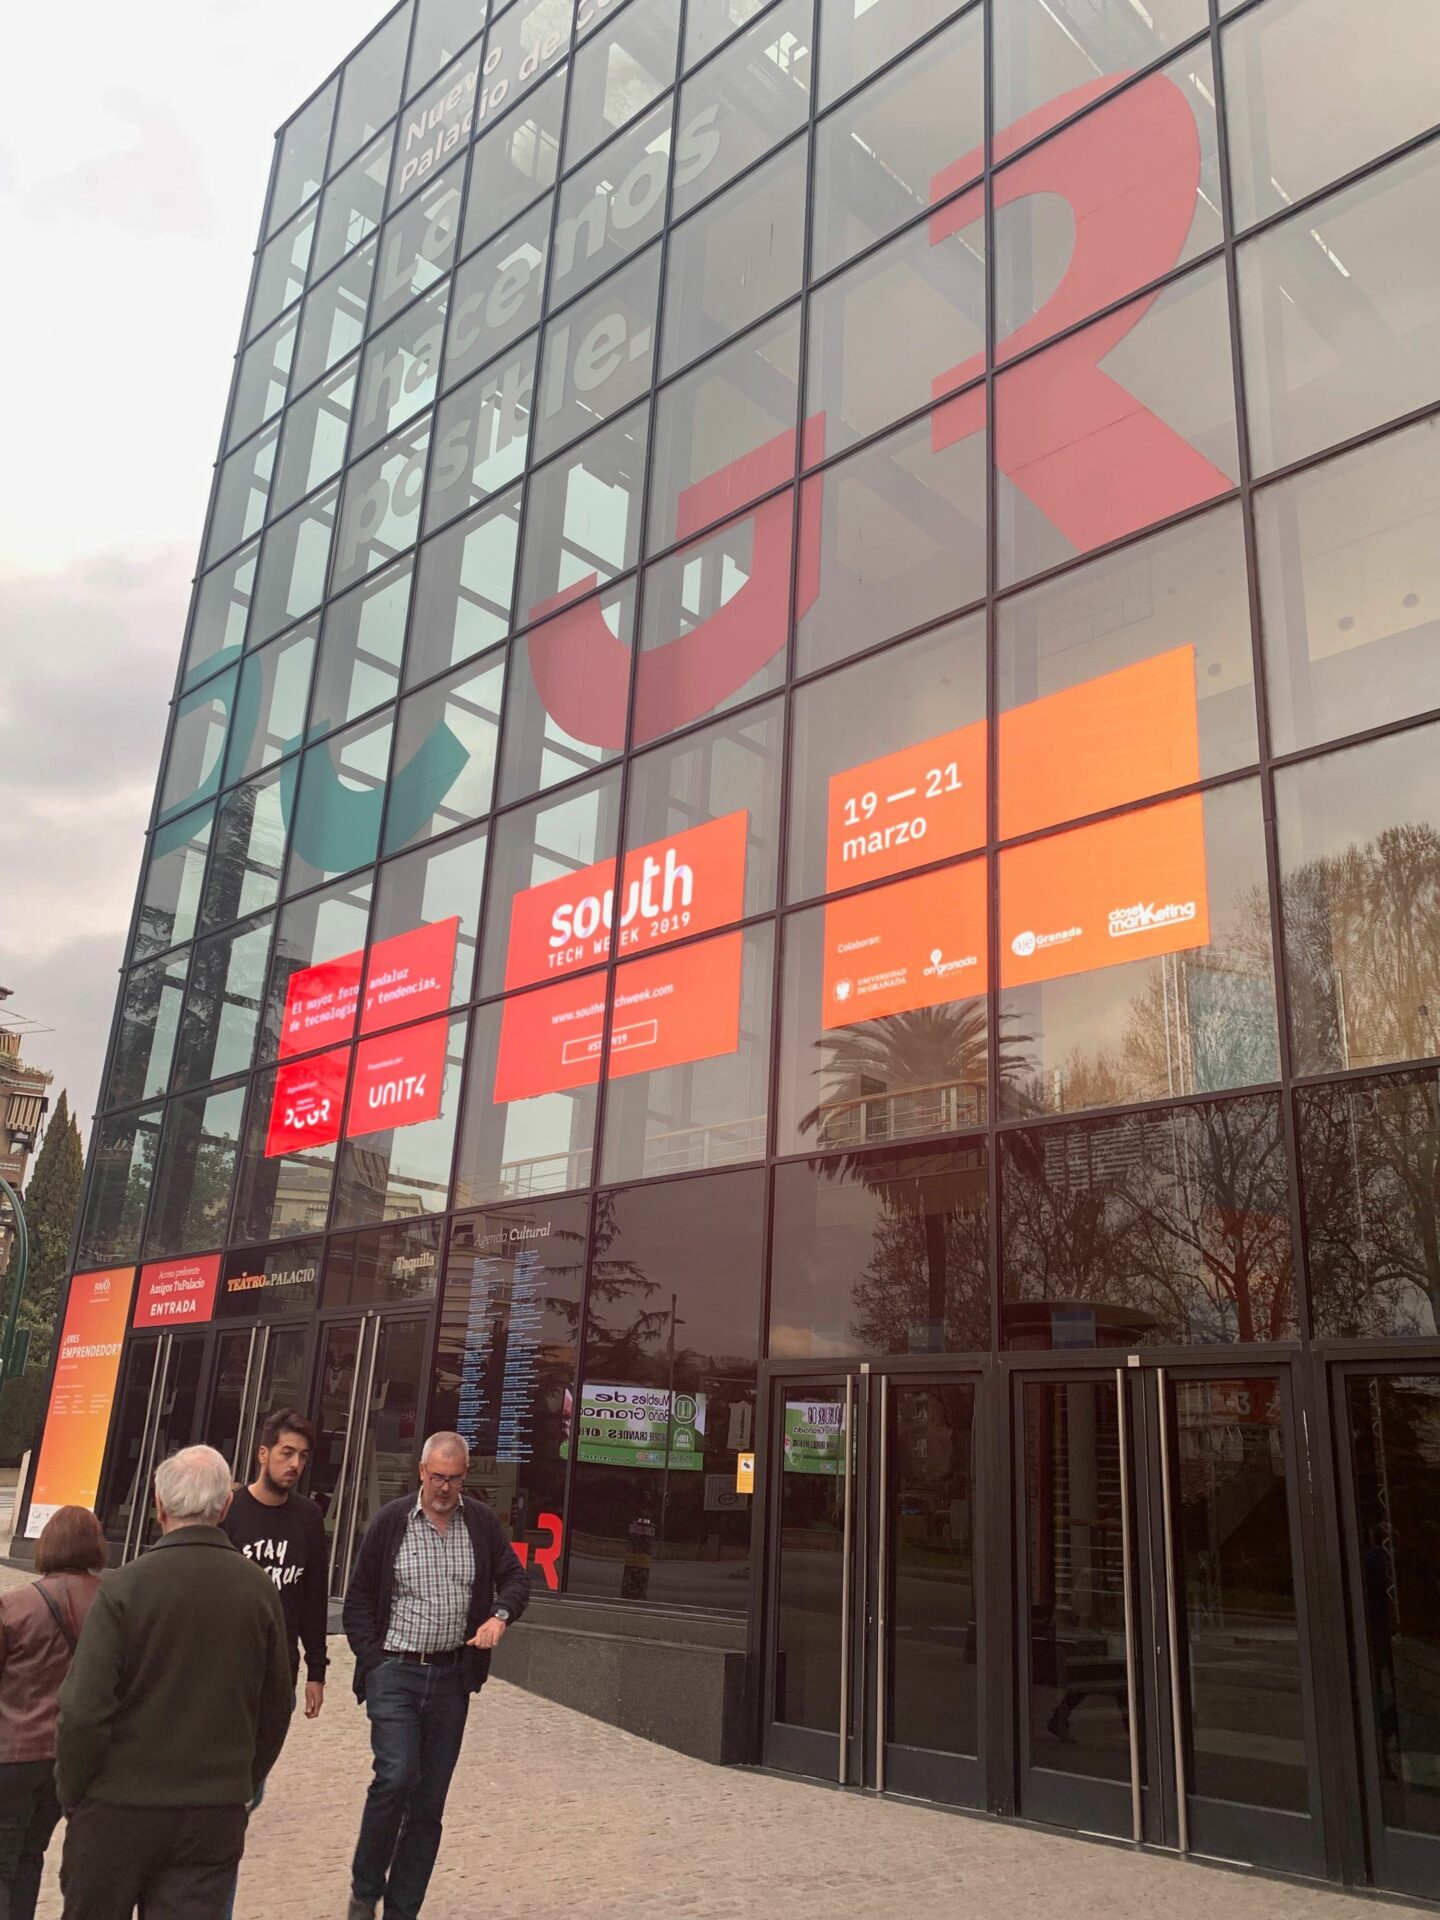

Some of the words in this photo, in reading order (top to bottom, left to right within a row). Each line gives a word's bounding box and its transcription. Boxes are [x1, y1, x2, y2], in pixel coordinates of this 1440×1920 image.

[518, 31, 561, 81] de
[406, 46, 502, 152] Nuevo
[383, 189, 461, 302] Lo
[362, 103, 720, 428] hacemos
[843, 791, 878, 827] 19
[925, 761, 963, 799] 21
[842, 816, 928, 862] marzo
[548, 848, 693, 948] south
[548, 945, 583, 968] TECH
[593, 927, 640, 954] WEEK
[650, 911, 691, 937] 2019
[1036, 927, 1083, 945] Granada
[292, 1002, 303, 1016] El
[306, 993, 333, 1011] mayor
[338, 984, 360, 1001] foro
[369, 968, 409, 990] andaluz
[857, 968, 907, 985] UNIVERSIDAD
[866, 977, 907, 993] GRANADA
[289, 1021, 300, 1033] de
[366, 999, 373, 1011] y
[552, 984, 674, 1024] www.southtchweek.com
[369, 1074, 426, 1109] UNIT4
[474, 1233, 508, 1249] Agenda
[509, 1222, 551, 1241] Cultural
[270, 1268, 315, 1287] PALACIO
[396, 1252, 434, 1271] Taquilla
[150, 1282, 173, 1296] Amigos
[174, 1277, 205, 1291] TuPalacio
[150, 1299, 196, 1317] ENTRADA
[242, 1539, 288, 1566] STAY
